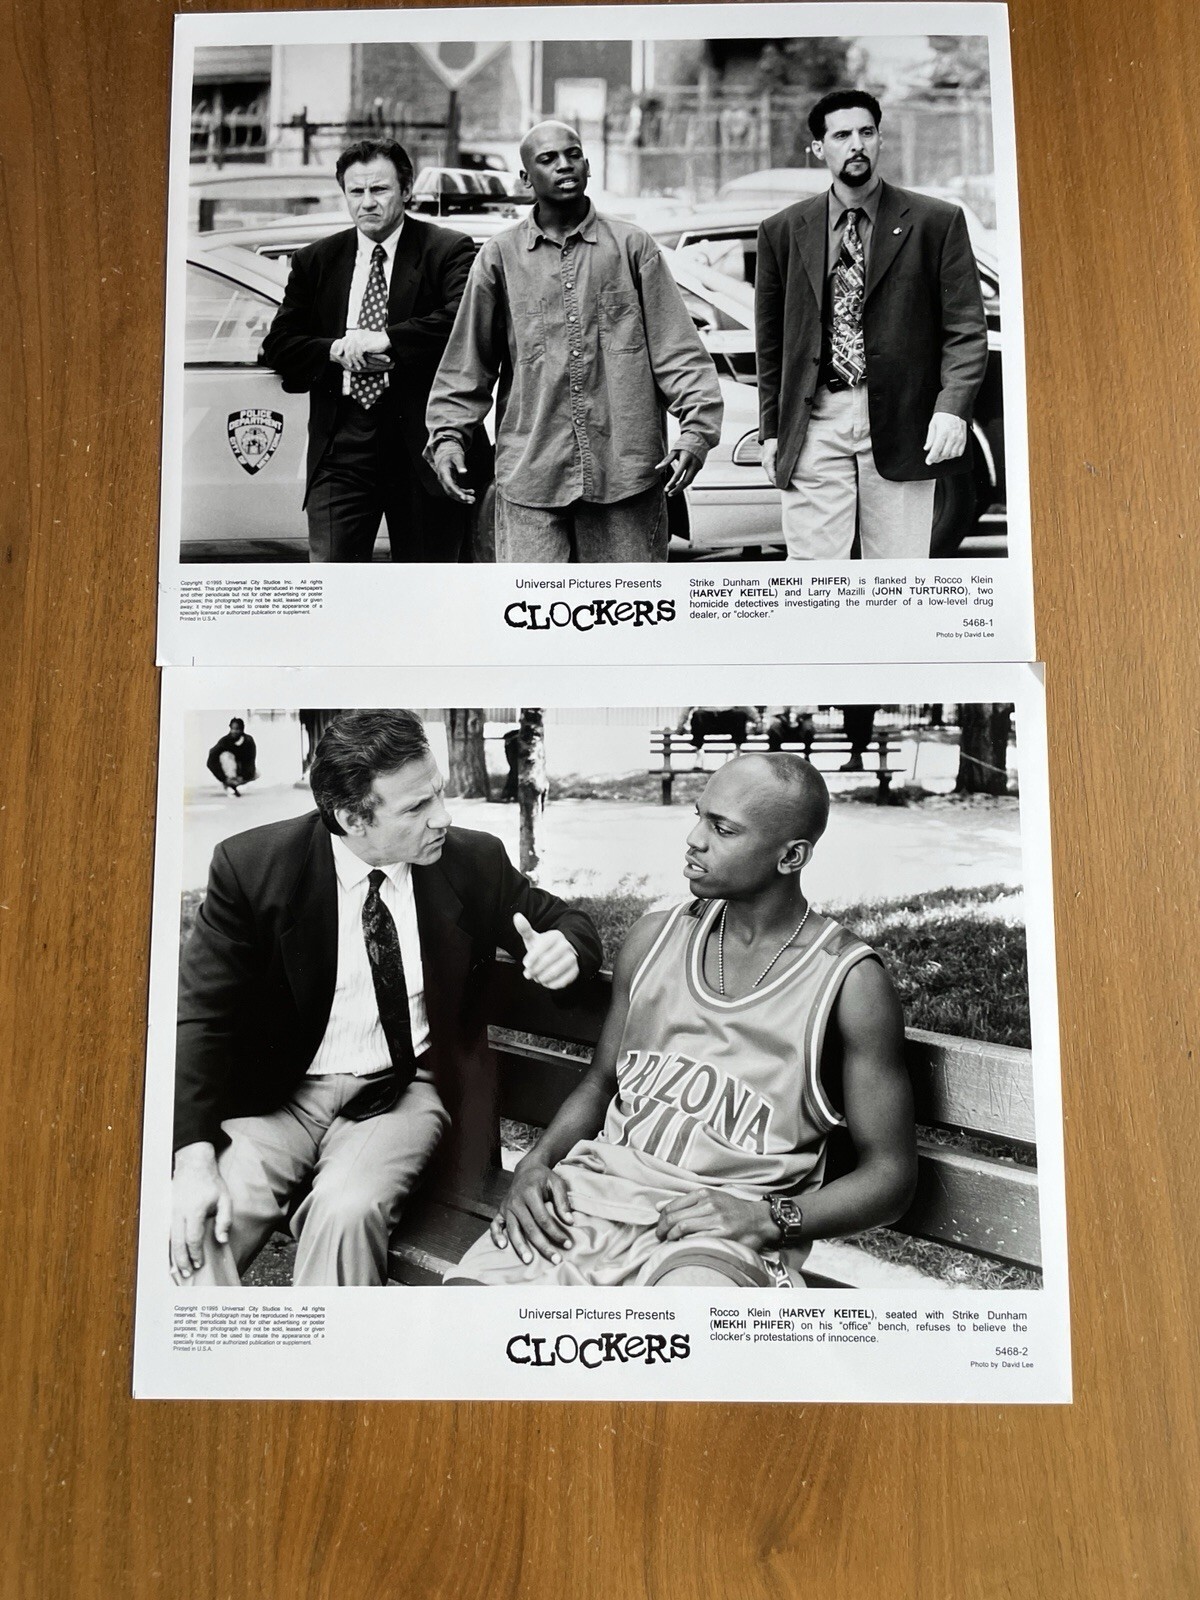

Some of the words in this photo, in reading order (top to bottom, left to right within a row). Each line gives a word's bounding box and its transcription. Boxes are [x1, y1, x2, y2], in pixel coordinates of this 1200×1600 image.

[240, 410, 272, 418] POLICE
[229, 418, 282, 430] DEPARTMENT
[516, 579, 566, 588] Universal
[568, 579, 612, 588] Pictures
[615, 579, 662, 588] Presents
[768, 578, 802, 587] (MEKHI
[811, 577, 850, 586] PHIFER)
[915, 576, 926, 586] by
[690, 589, 732, 598] (HARVEY
[740, 589, 778, 598] KEITEL)
[808, 588, 830, 597] Larry
[872, 587, 902, 596] (JOHN
[911, 587, 970, 596] TURTURRO),
[785, 599, 840, 608] investigating
[974, 598, 993, 607] drug
[690, 611, 720, 619] dealer,
[519, 1309, 572, 1319] Universal
[576, 1309, 621, 1319] Pictures
[626, 1309, 675, 1320] Presents
[710, 1308, 740, 1316] Rocco
[747, 1308, 771, 1317] Klein
[778, 1309, 825, 1319] (HARVEY
[832, 1309, 878, 1320] KEITEL),
[885, 1310, 918, 1319] seated
[925, 1311, 944, 1319] with
[952, 1311, 980, 1319] Strike
[987, 1311, 1028, 1320] Dunham
[710, 1320, 746, 1330] (MEKHI
[754, 1320, 794, 1331] PHIFER)
[819, 1321, 832, 1330] his
[878, 1322, 909, 1331] bench,
[916, 1322, 950, 1331] refuses
[973, 1323, 1006, 1332] believe
[1013, 1323, 1027, 1332] the
[710, 1332, 751, 1341] clocker's
[754, 1333, 813, 1343] protestations
[816, 1333, 825, 1342] of
[828, 1333, 878, 1342] innocence.
[995, 1347, 1028, 1355] 5468-2
